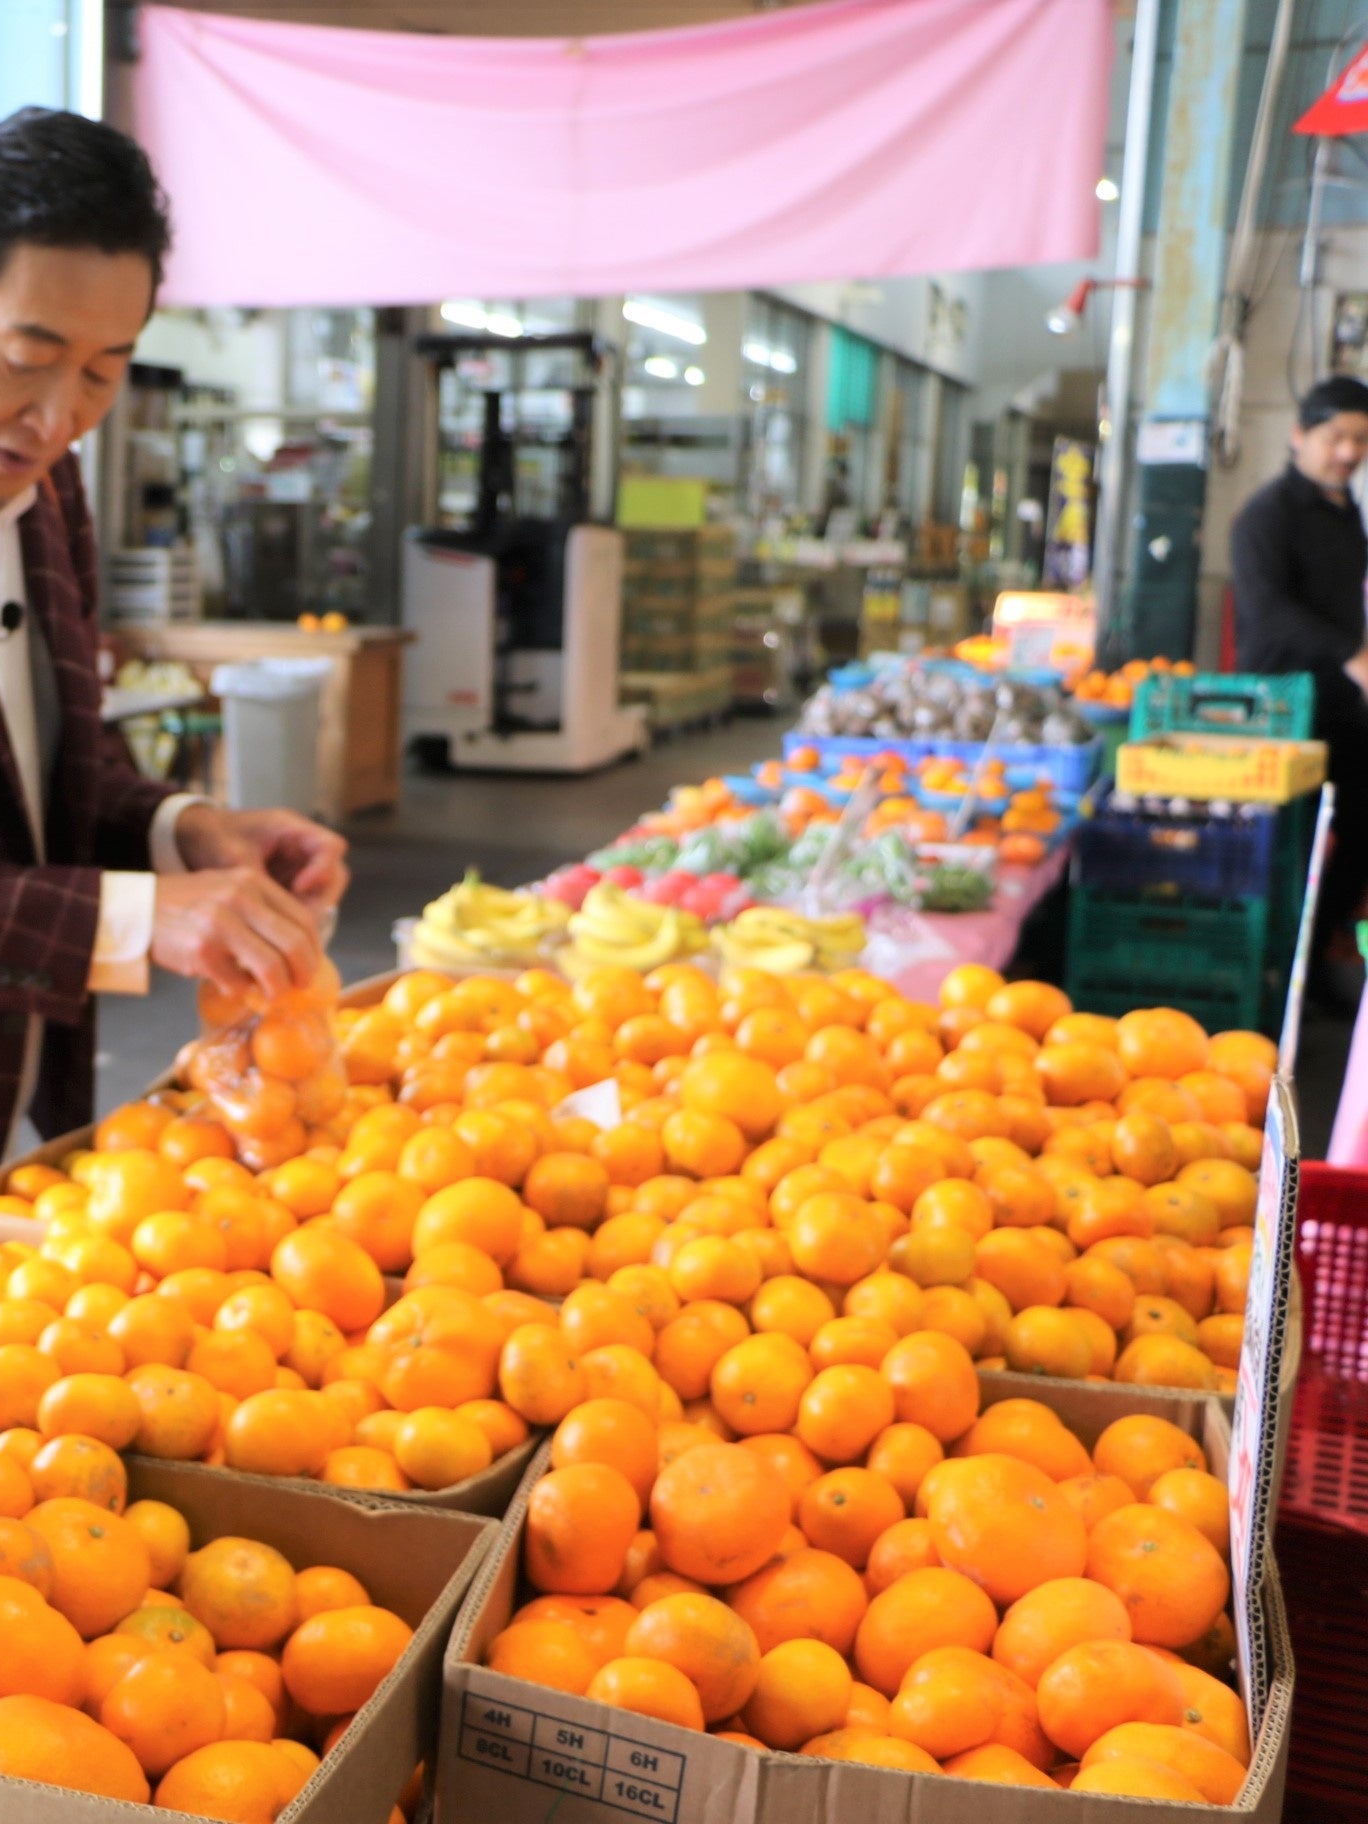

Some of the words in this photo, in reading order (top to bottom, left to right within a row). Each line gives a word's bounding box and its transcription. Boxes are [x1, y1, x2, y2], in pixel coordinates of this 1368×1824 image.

[484, 1709, 511, 1728] 4H
[556, 1729, 584, 1749] 5H
[630, 1751, 658, 1772] 6H
[543, 1759, 590, 1786] 10CL
[615, 1781, 665, 1809] 16CL
